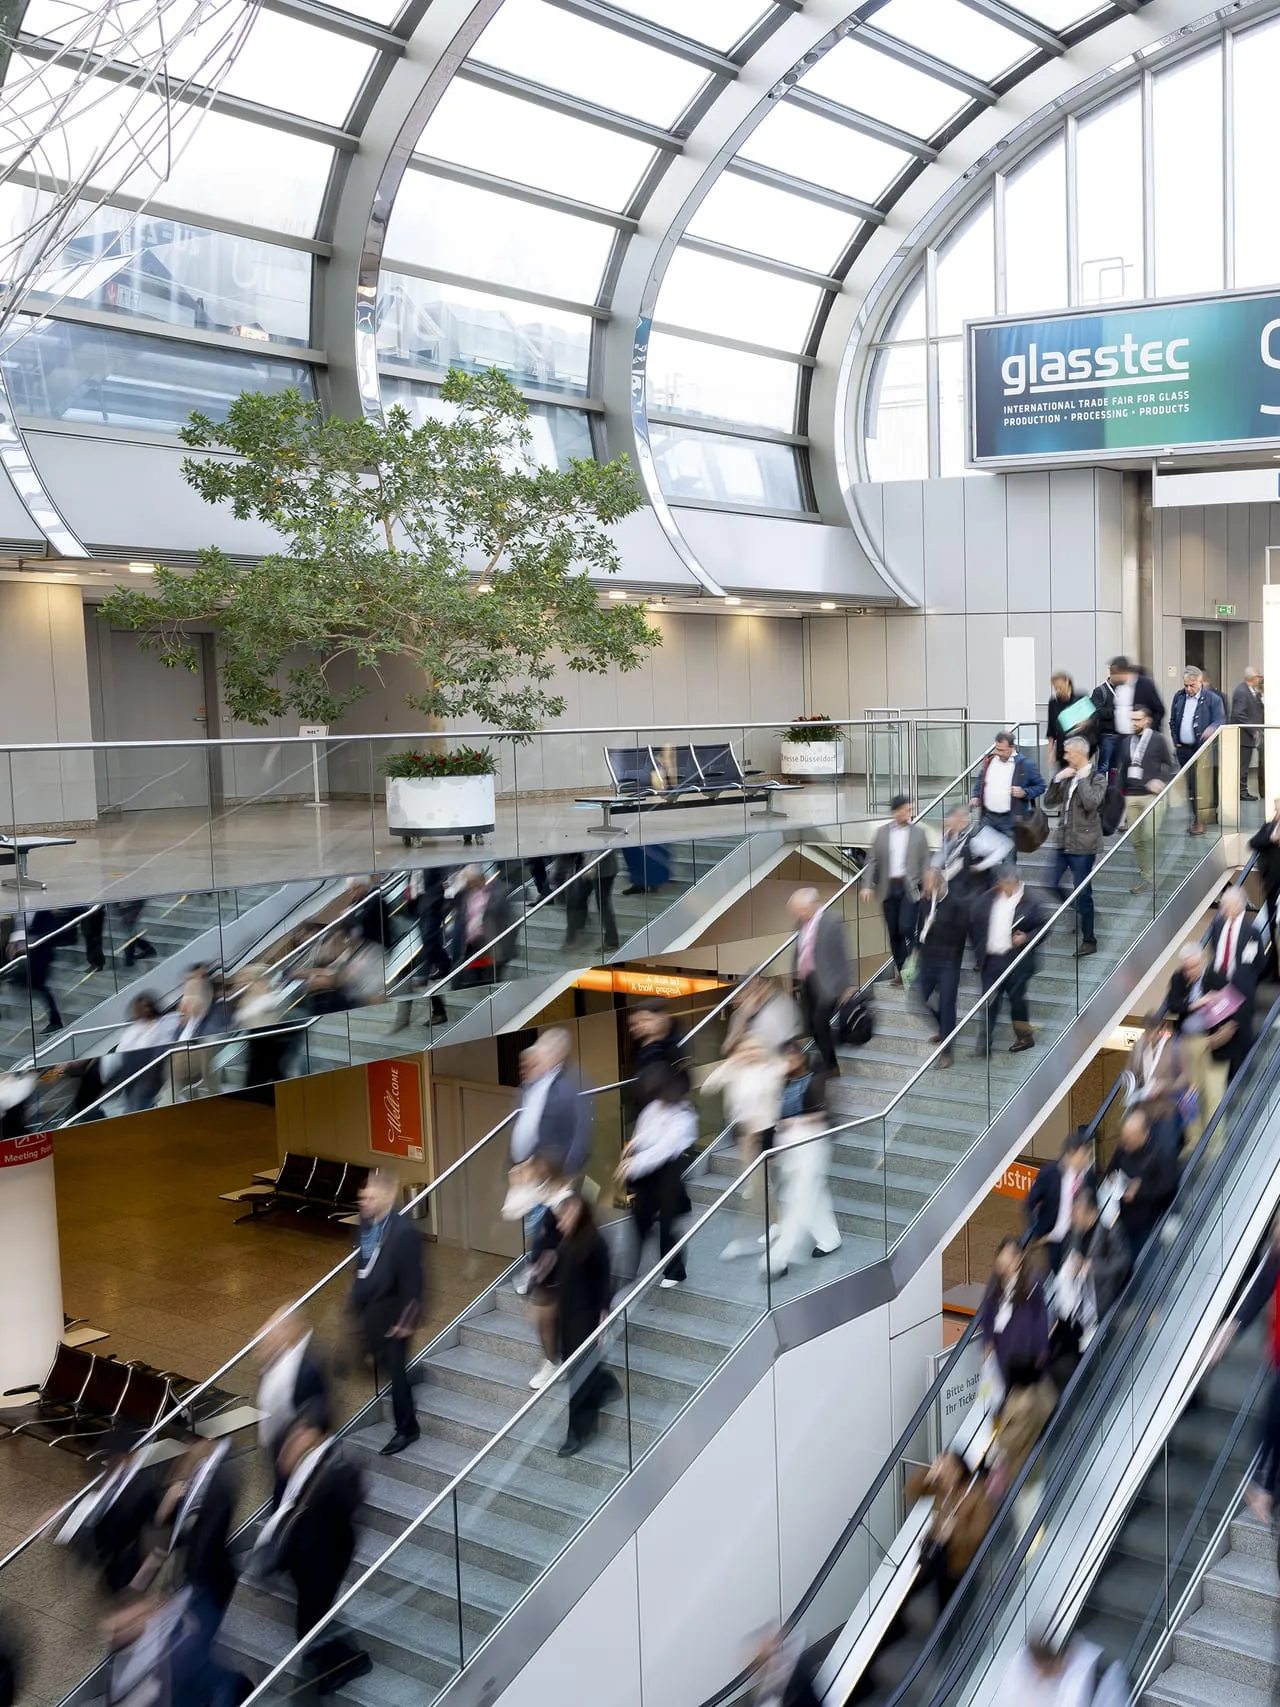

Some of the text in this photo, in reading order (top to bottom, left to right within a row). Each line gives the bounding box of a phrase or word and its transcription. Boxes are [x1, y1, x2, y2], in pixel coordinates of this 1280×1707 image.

[1001, 333, 1190, 396] glasstec
[1003, 390, 1190, 414] INTERNATIONAL TRADE FAIR FOR GLASS
[1003, 403, 1190, 426] PRODUCTION PROCESSING PRODUCTS
[4, 1150, 39, 1163] Meeting
[946, 1383, 964, 1400] Bitte
[945, 1402, 957, 1416] Ihr
